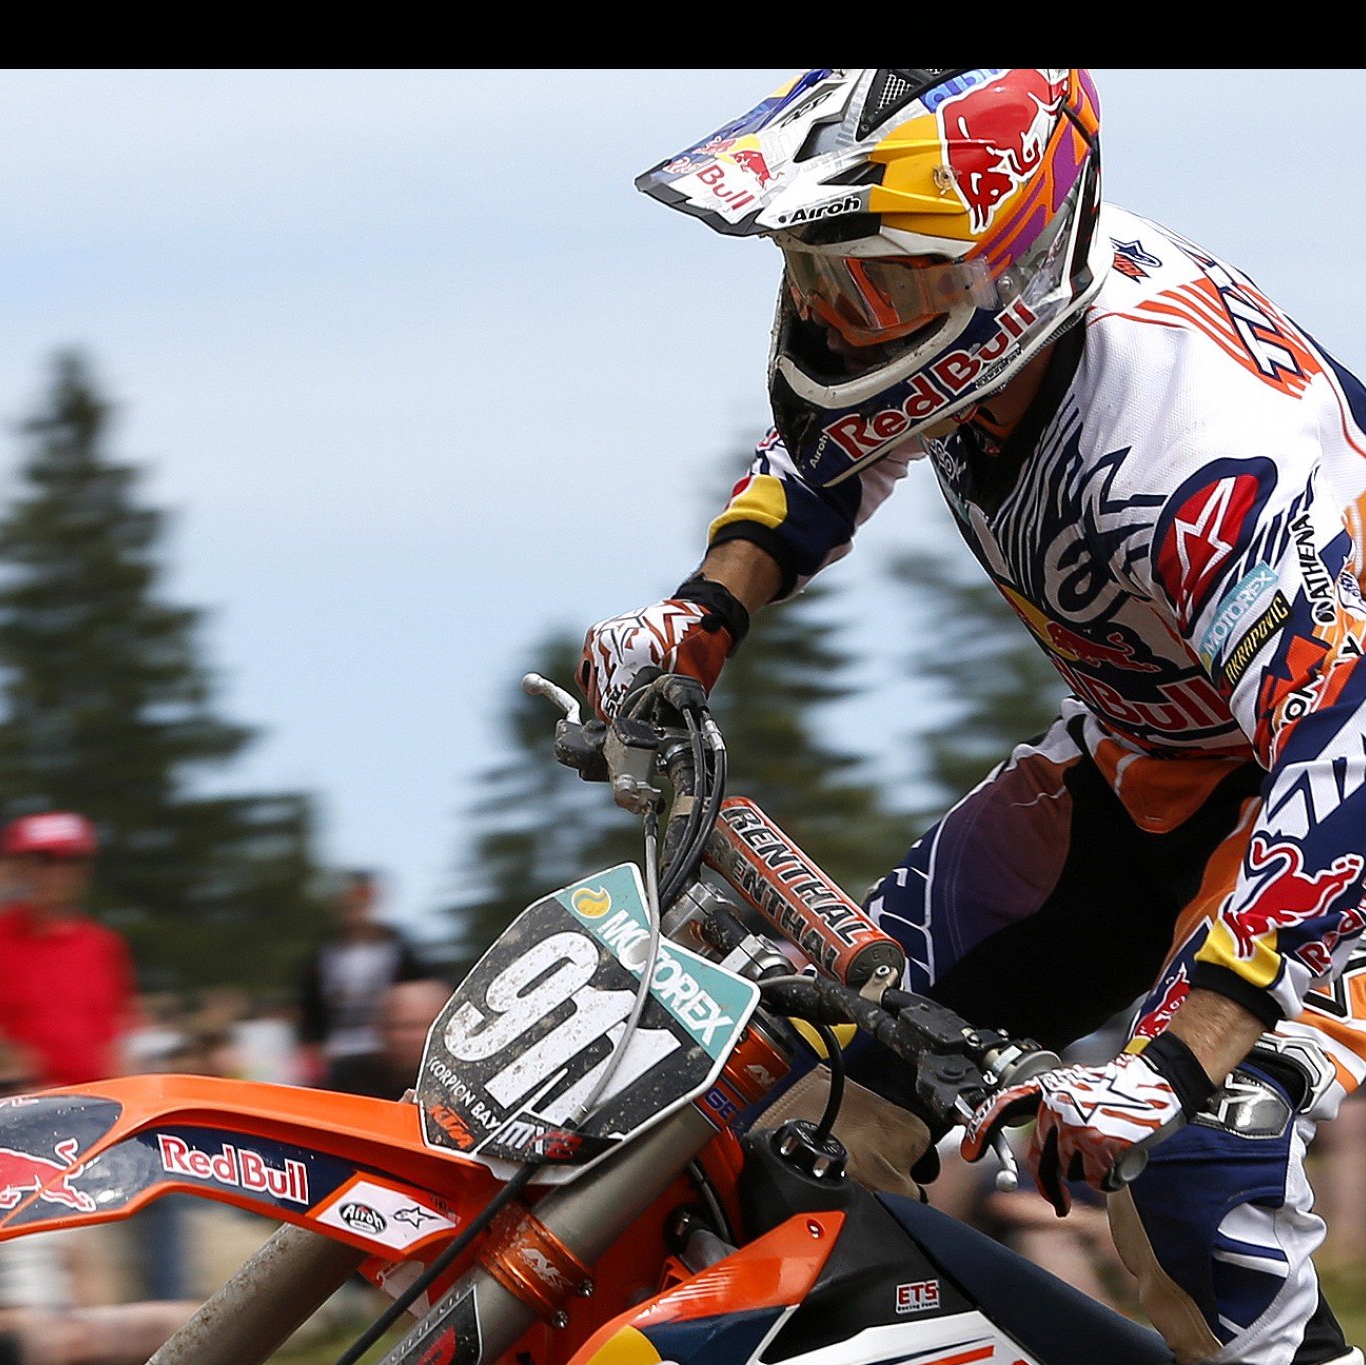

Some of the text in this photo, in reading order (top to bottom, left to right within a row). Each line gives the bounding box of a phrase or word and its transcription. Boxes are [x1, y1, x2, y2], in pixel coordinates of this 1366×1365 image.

[696, 163, 756, 211] Bull
[823, 372, 950, 463] Red
[930, 295, 1040, 397] Bull
[1291, 512, 1336, 600] ATHENA
[1204, 570, 1275, 659] MOTOREX
[1074, 667, 1237, 732] Bull
[720, 805, 872, 949] RENTHAL
[598, 908, 735, 1047] MOTOREX
[443, 931, 682, 1128] 911
[426, 1056, 502, 1131] SCORPION BAY
[157, 1134, 309, 1206] Red Bull
[898, 1282, 937, 1305] ETS
